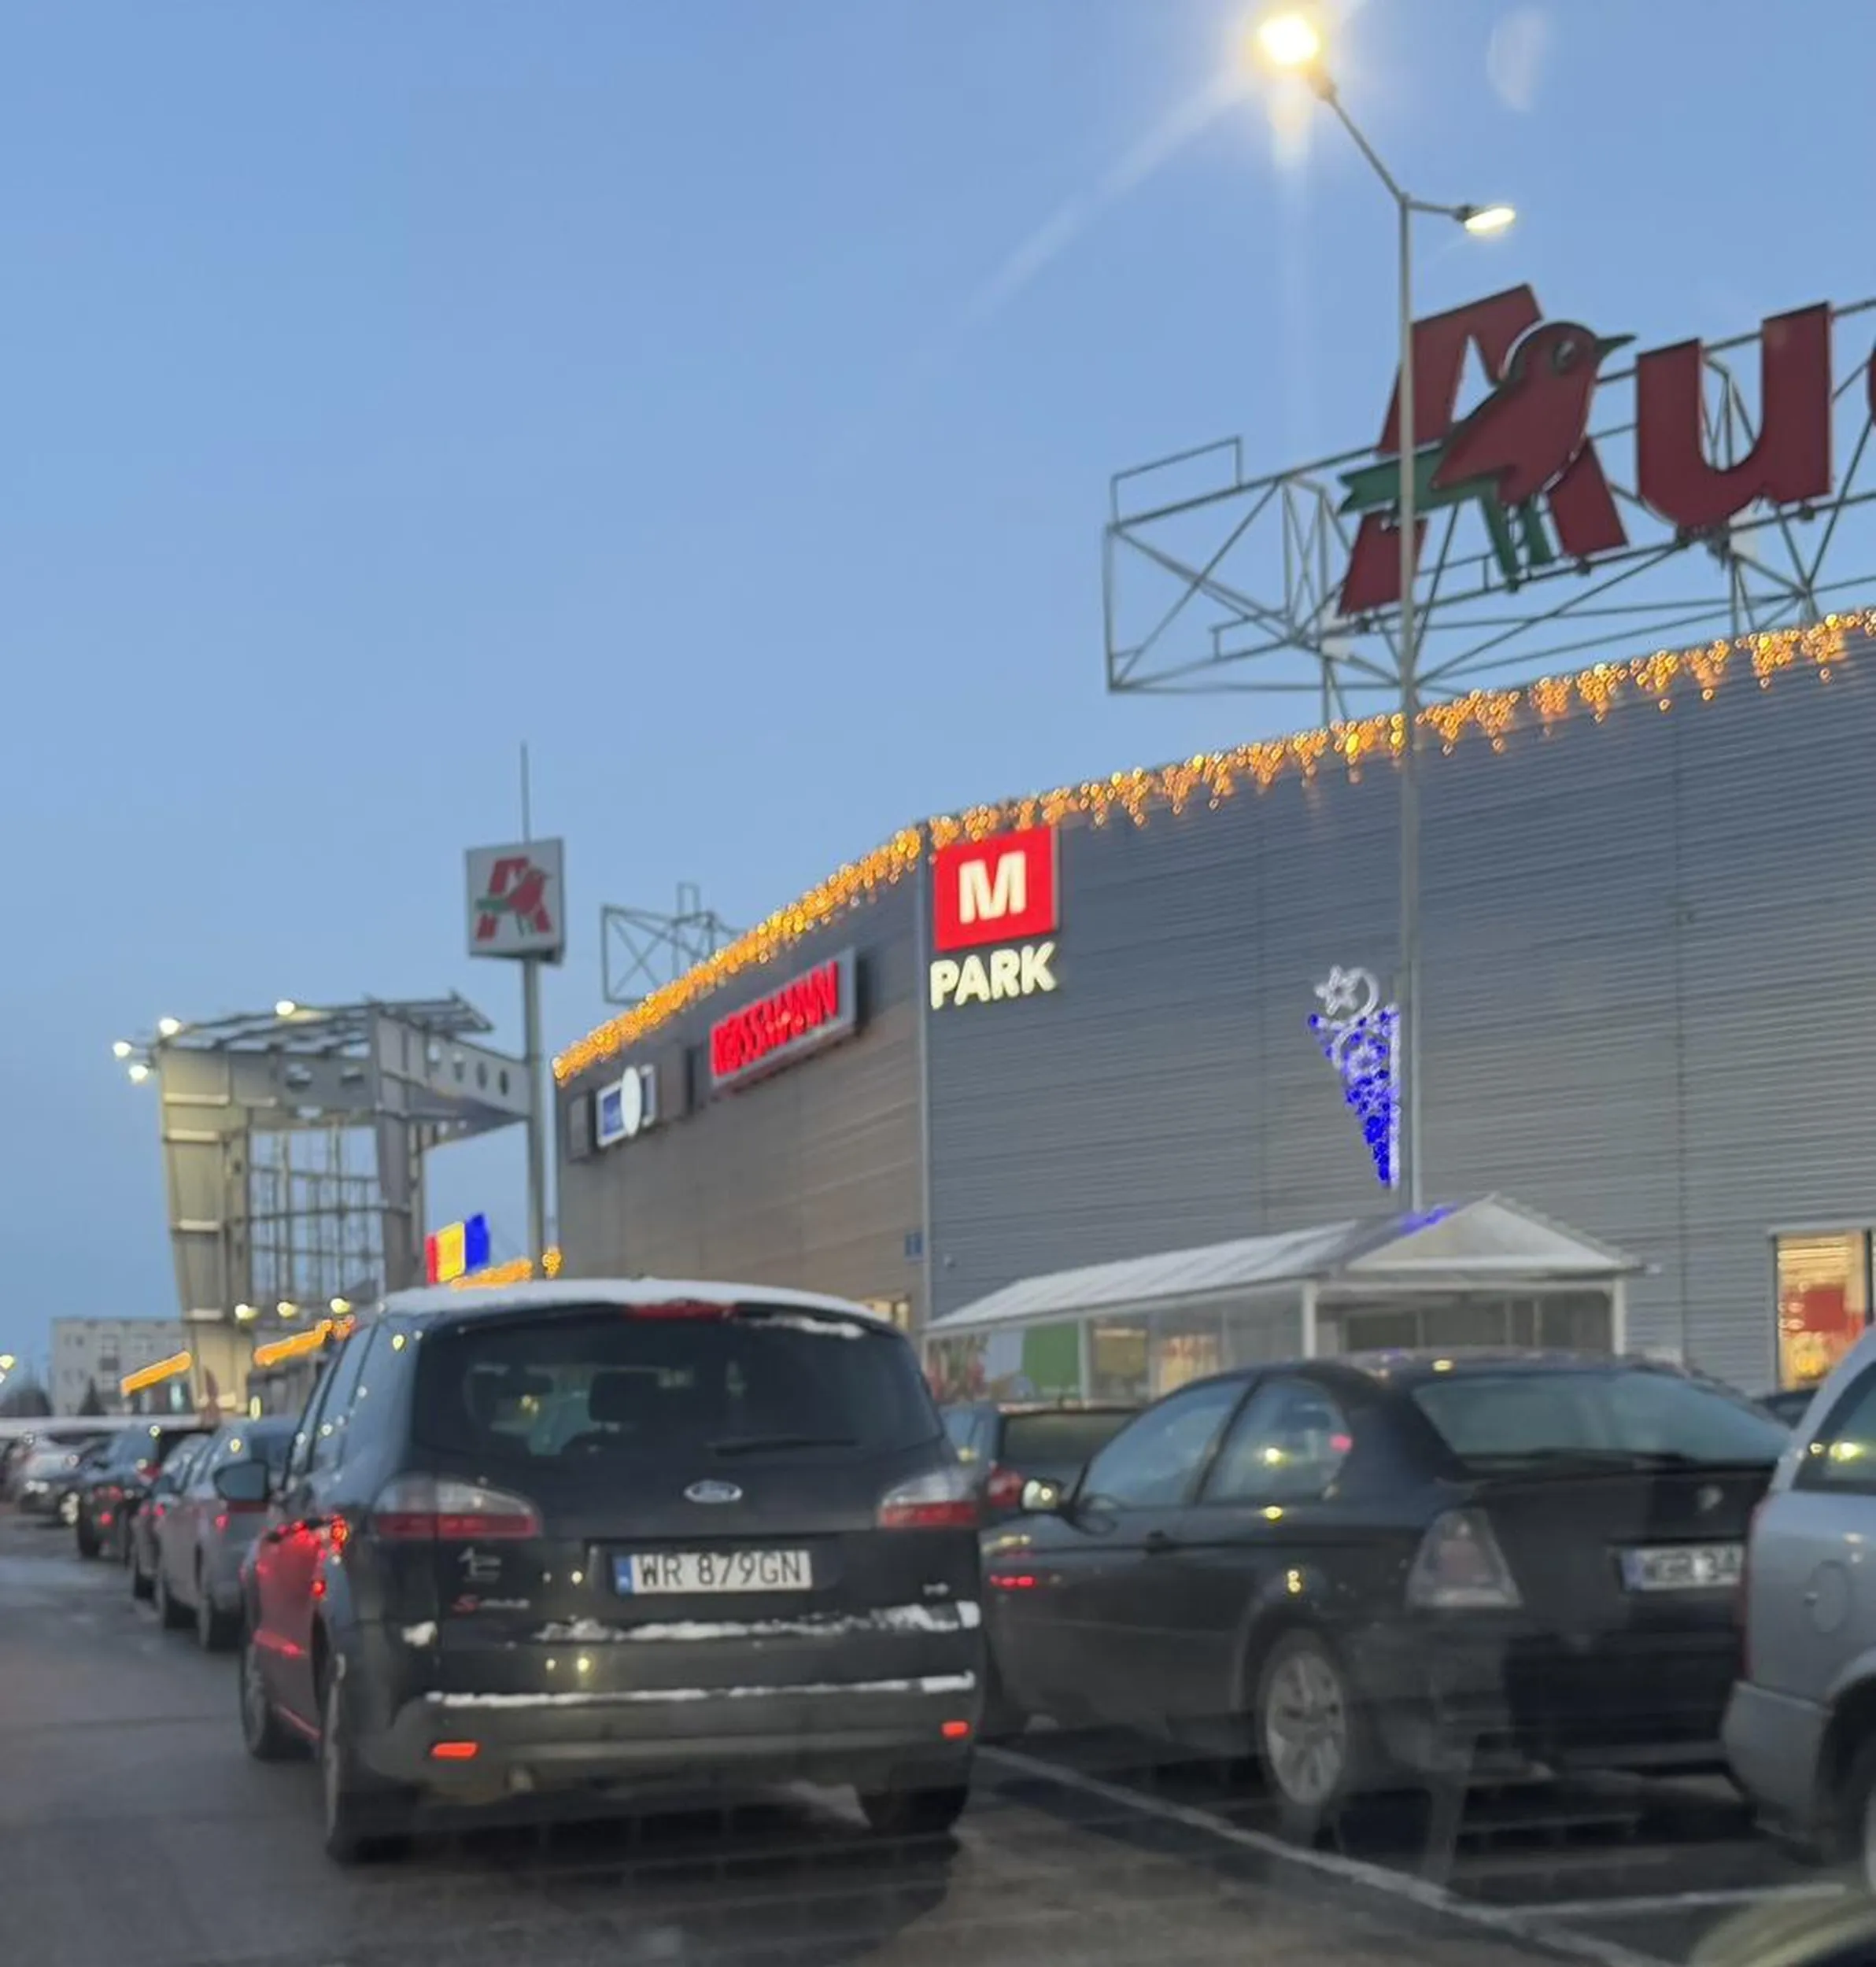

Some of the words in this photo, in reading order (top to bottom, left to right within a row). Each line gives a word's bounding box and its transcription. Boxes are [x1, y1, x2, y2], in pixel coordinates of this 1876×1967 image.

[1338, 283, 1876, 618] Au
[958, 851, 1026, 924] M
[930, 941, 1057, 1010] PARK
[639, 1554, 681, 1586] WR
[697, 1550, 802, 1585] 879GN
